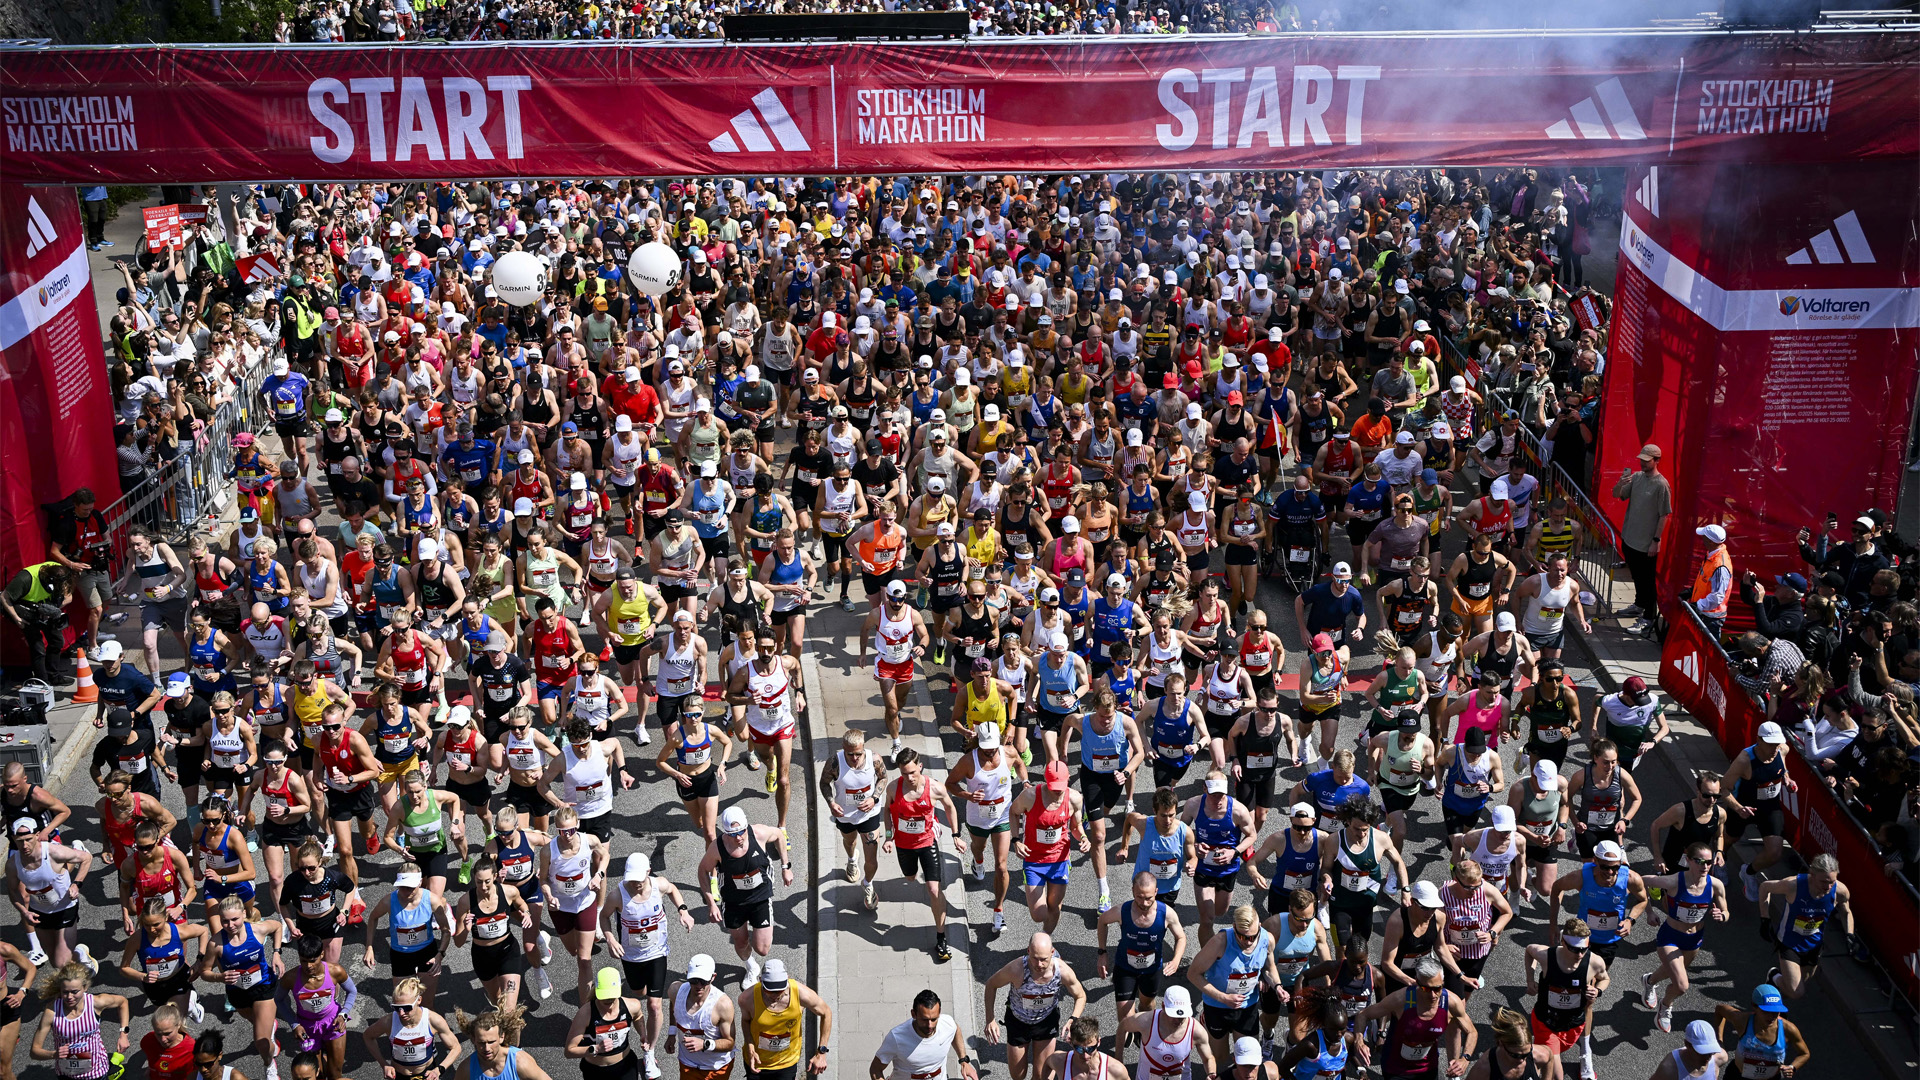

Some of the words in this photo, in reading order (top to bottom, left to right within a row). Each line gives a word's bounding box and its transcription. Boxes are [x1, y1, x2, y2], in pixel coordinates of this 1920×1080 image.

[857, 88, 985, 117] STOCKHOLM
[1699, 79, 1833, 107] STOCKHOLM
[2, 96, 134, 124] STOCKHOLM
[308, 75, 532, 164] START
[1156, 65, 1382, 150] START
[1697, 107, 1830, 134] MARATHON
[8, 124, 138, 152] MARATHON
[858, 117, 986, 145] MARATHON
[1635, 235, 1655, 264] Voltaren
[499, 284, 531, 292] GARMIN
[630, 269, 659, 283] GARMIN
[1801, 297, 1870, 313] Voltaren
[1841, 314, 1861, 322] glädje
